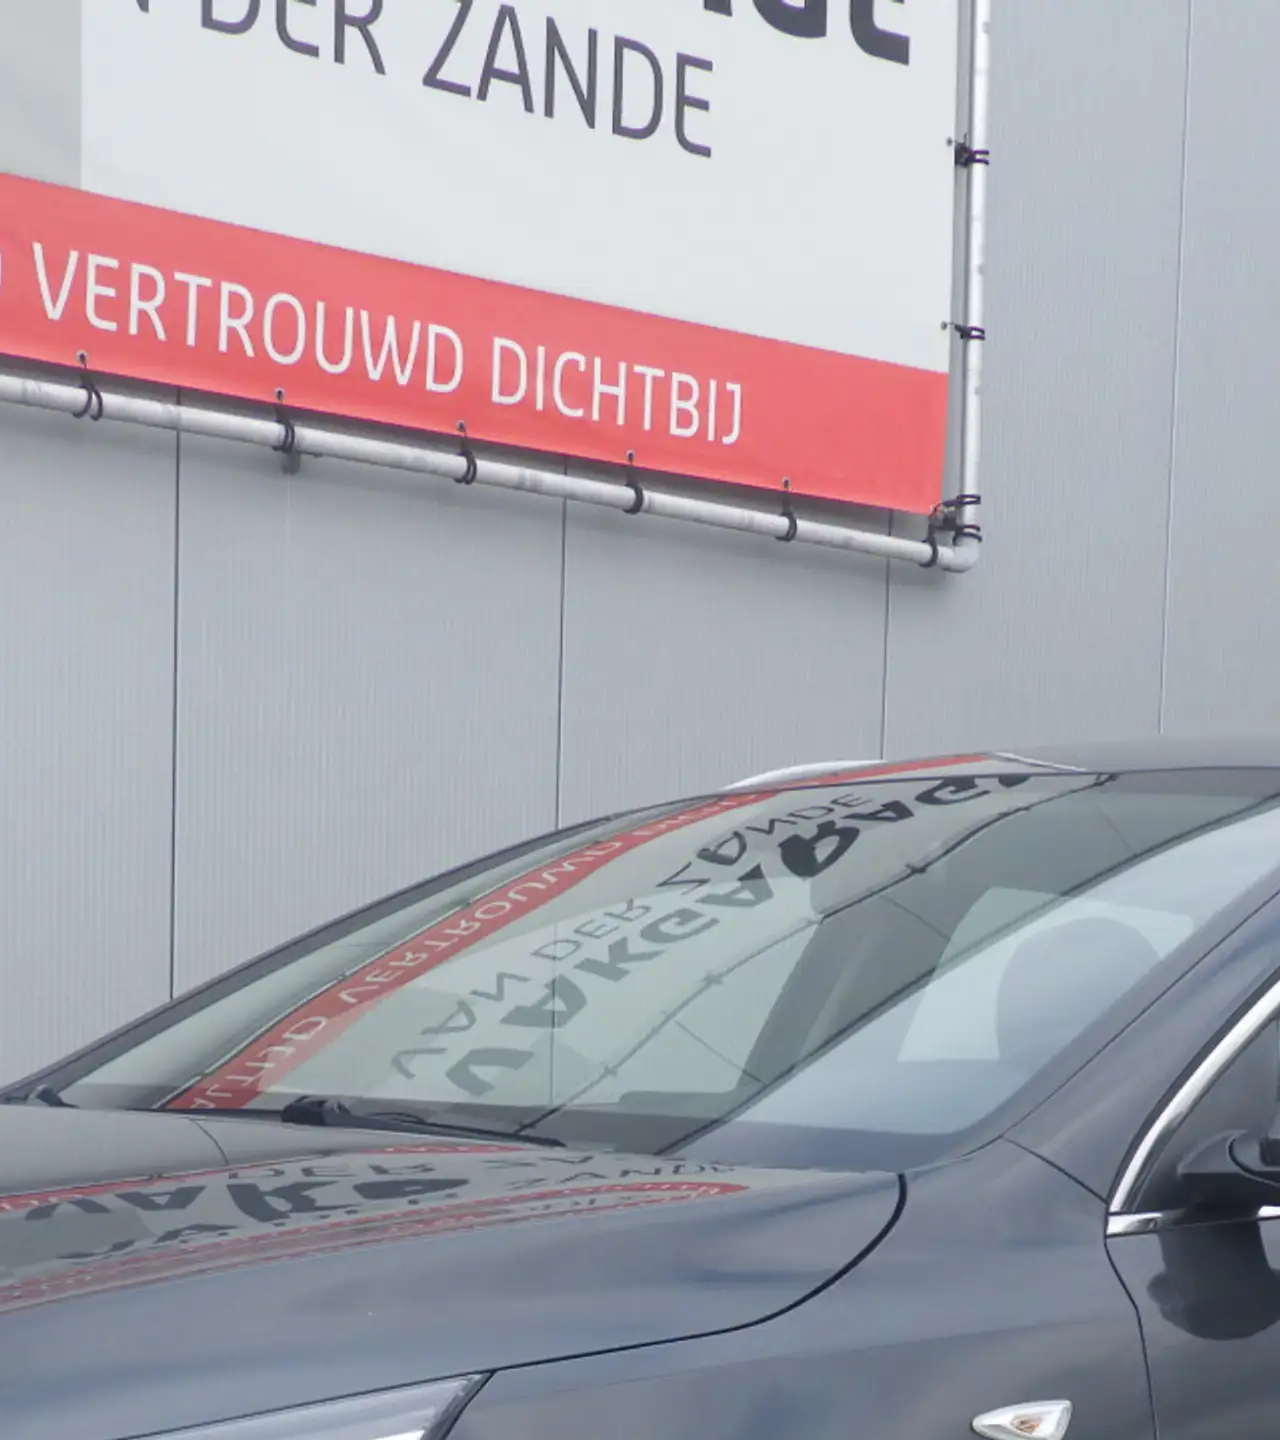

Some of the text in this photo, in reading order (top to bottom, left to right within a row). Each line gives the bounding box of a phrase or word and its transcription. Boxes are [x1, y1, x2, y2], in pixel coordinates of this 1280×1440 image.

[422, 0, 714, 159] ZANDE
[32, 241, 465, 394] VERTROUWD
[491, 336, 743, 446] DICHTBIJ
